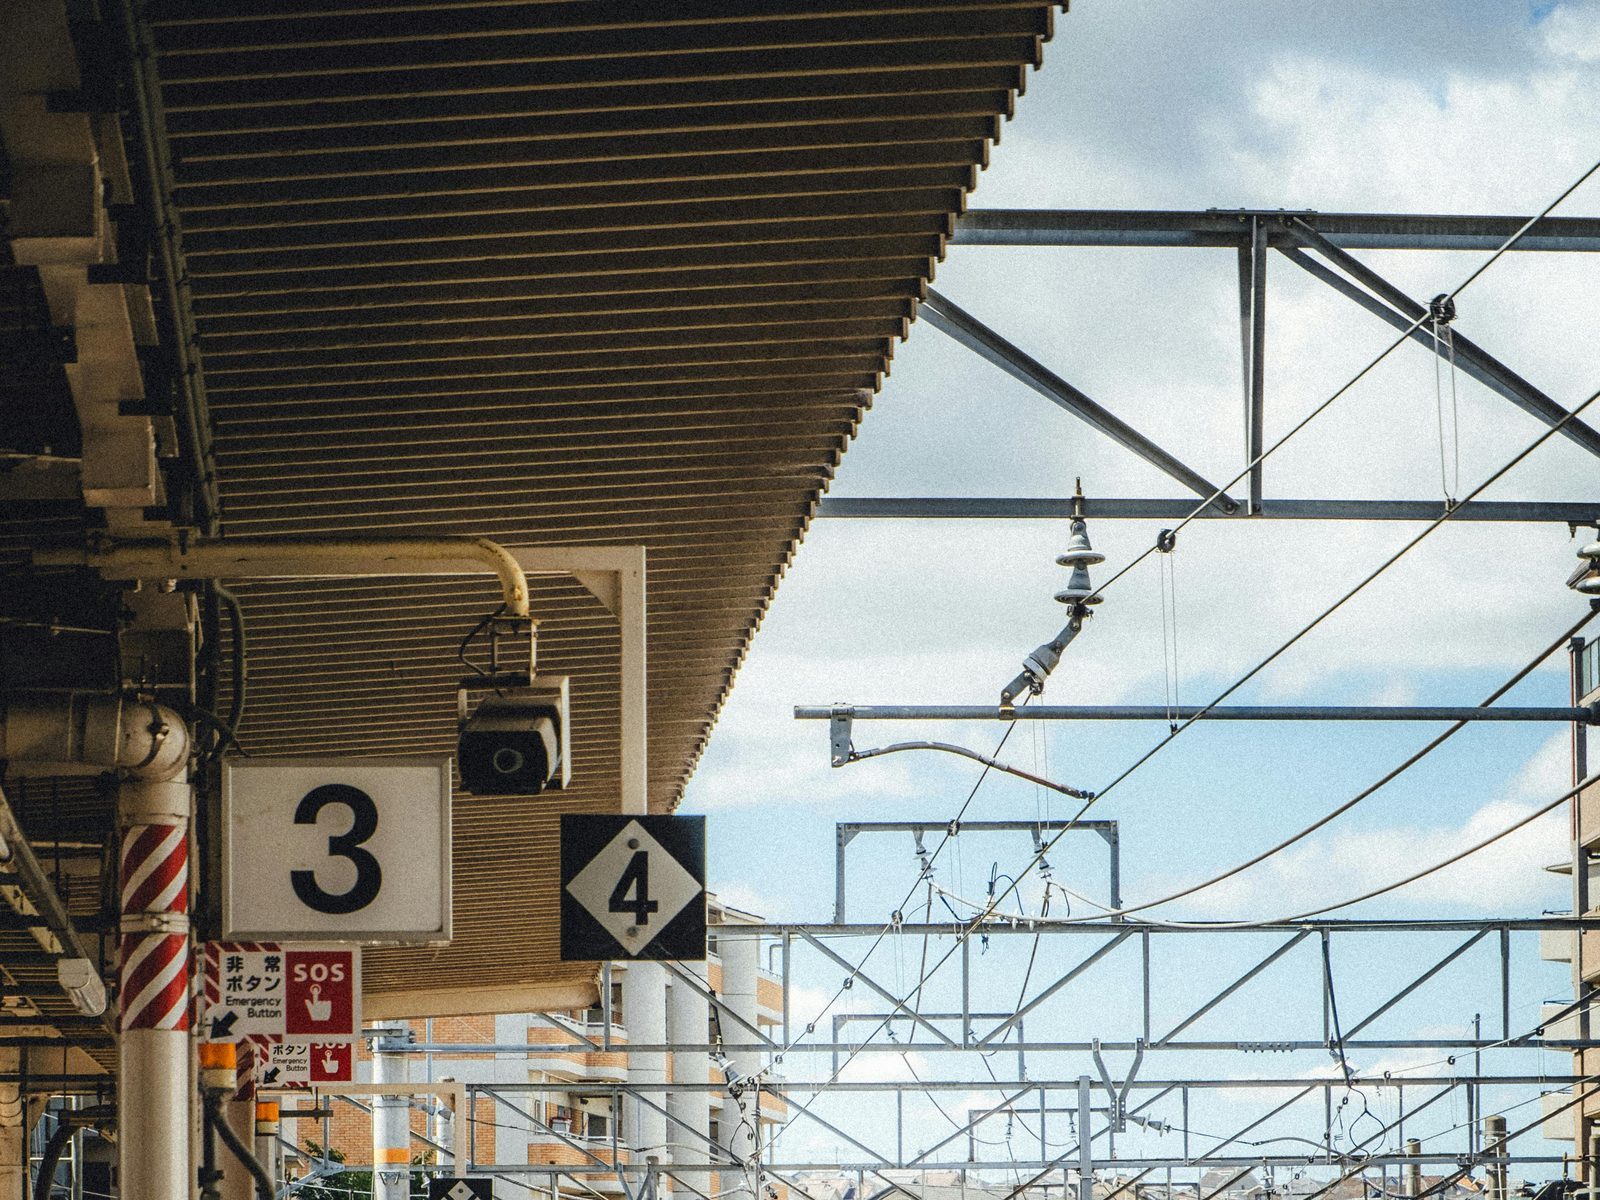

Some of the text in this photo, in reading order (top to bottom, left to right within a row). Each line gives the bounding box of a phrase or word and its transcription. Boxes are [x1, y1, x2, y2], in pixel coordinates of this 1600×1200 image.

[291, 784, 382, 914] 3
[608, 852, 657, 926] 4
[227, 957, 280, 972] 非常
[294, 964, 345, 982] SOS
[227, 975, 281, 992] ボタン
[225, 997, 281, 1007] Emergency
[247, 1008, 281, 1018] Button
[273, 1045, 307, 1056] ボタン
[272, 1058, 307, 1066] Emergency
